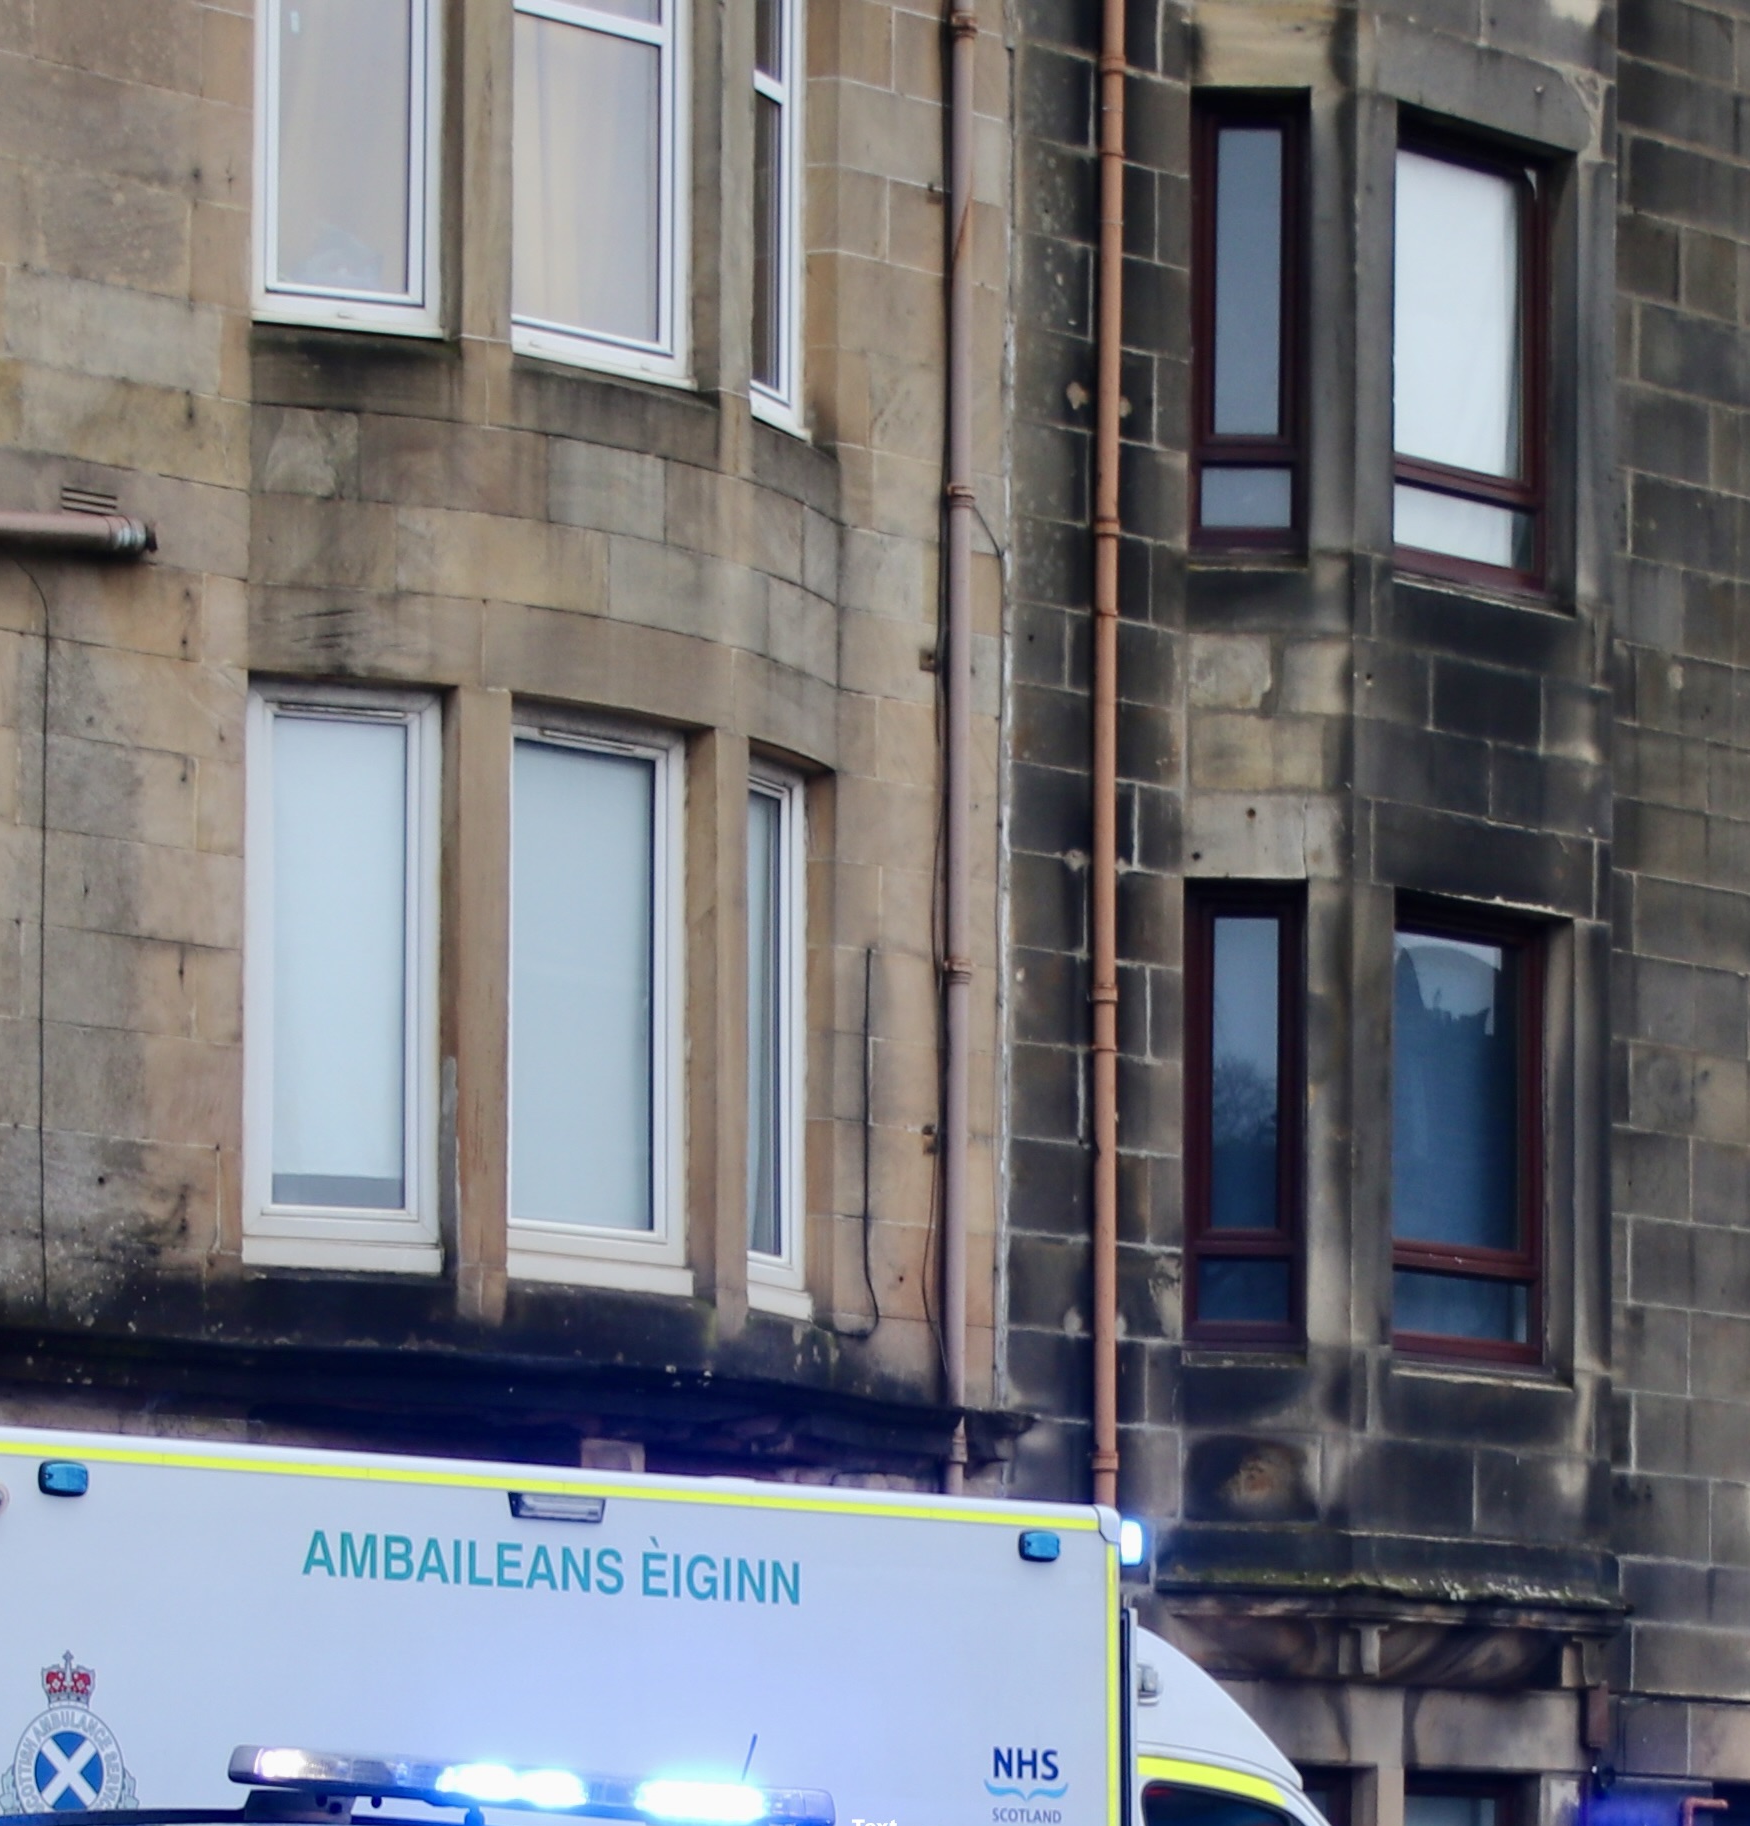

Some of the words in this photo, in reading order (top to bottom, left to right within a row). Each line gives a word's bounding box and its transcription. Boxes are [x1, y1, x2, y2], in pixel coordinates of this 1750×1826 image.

[302, 1529, 625, 1596] AMBAILEANS
[641, 1536, 801, 1606] ÈIGINN
[35, 1710, 113, 1752] AMBULANCE
[993, 1746, 1060, 1781] NHS
[992, 1806, 1062, 1823] SCOTLAND
